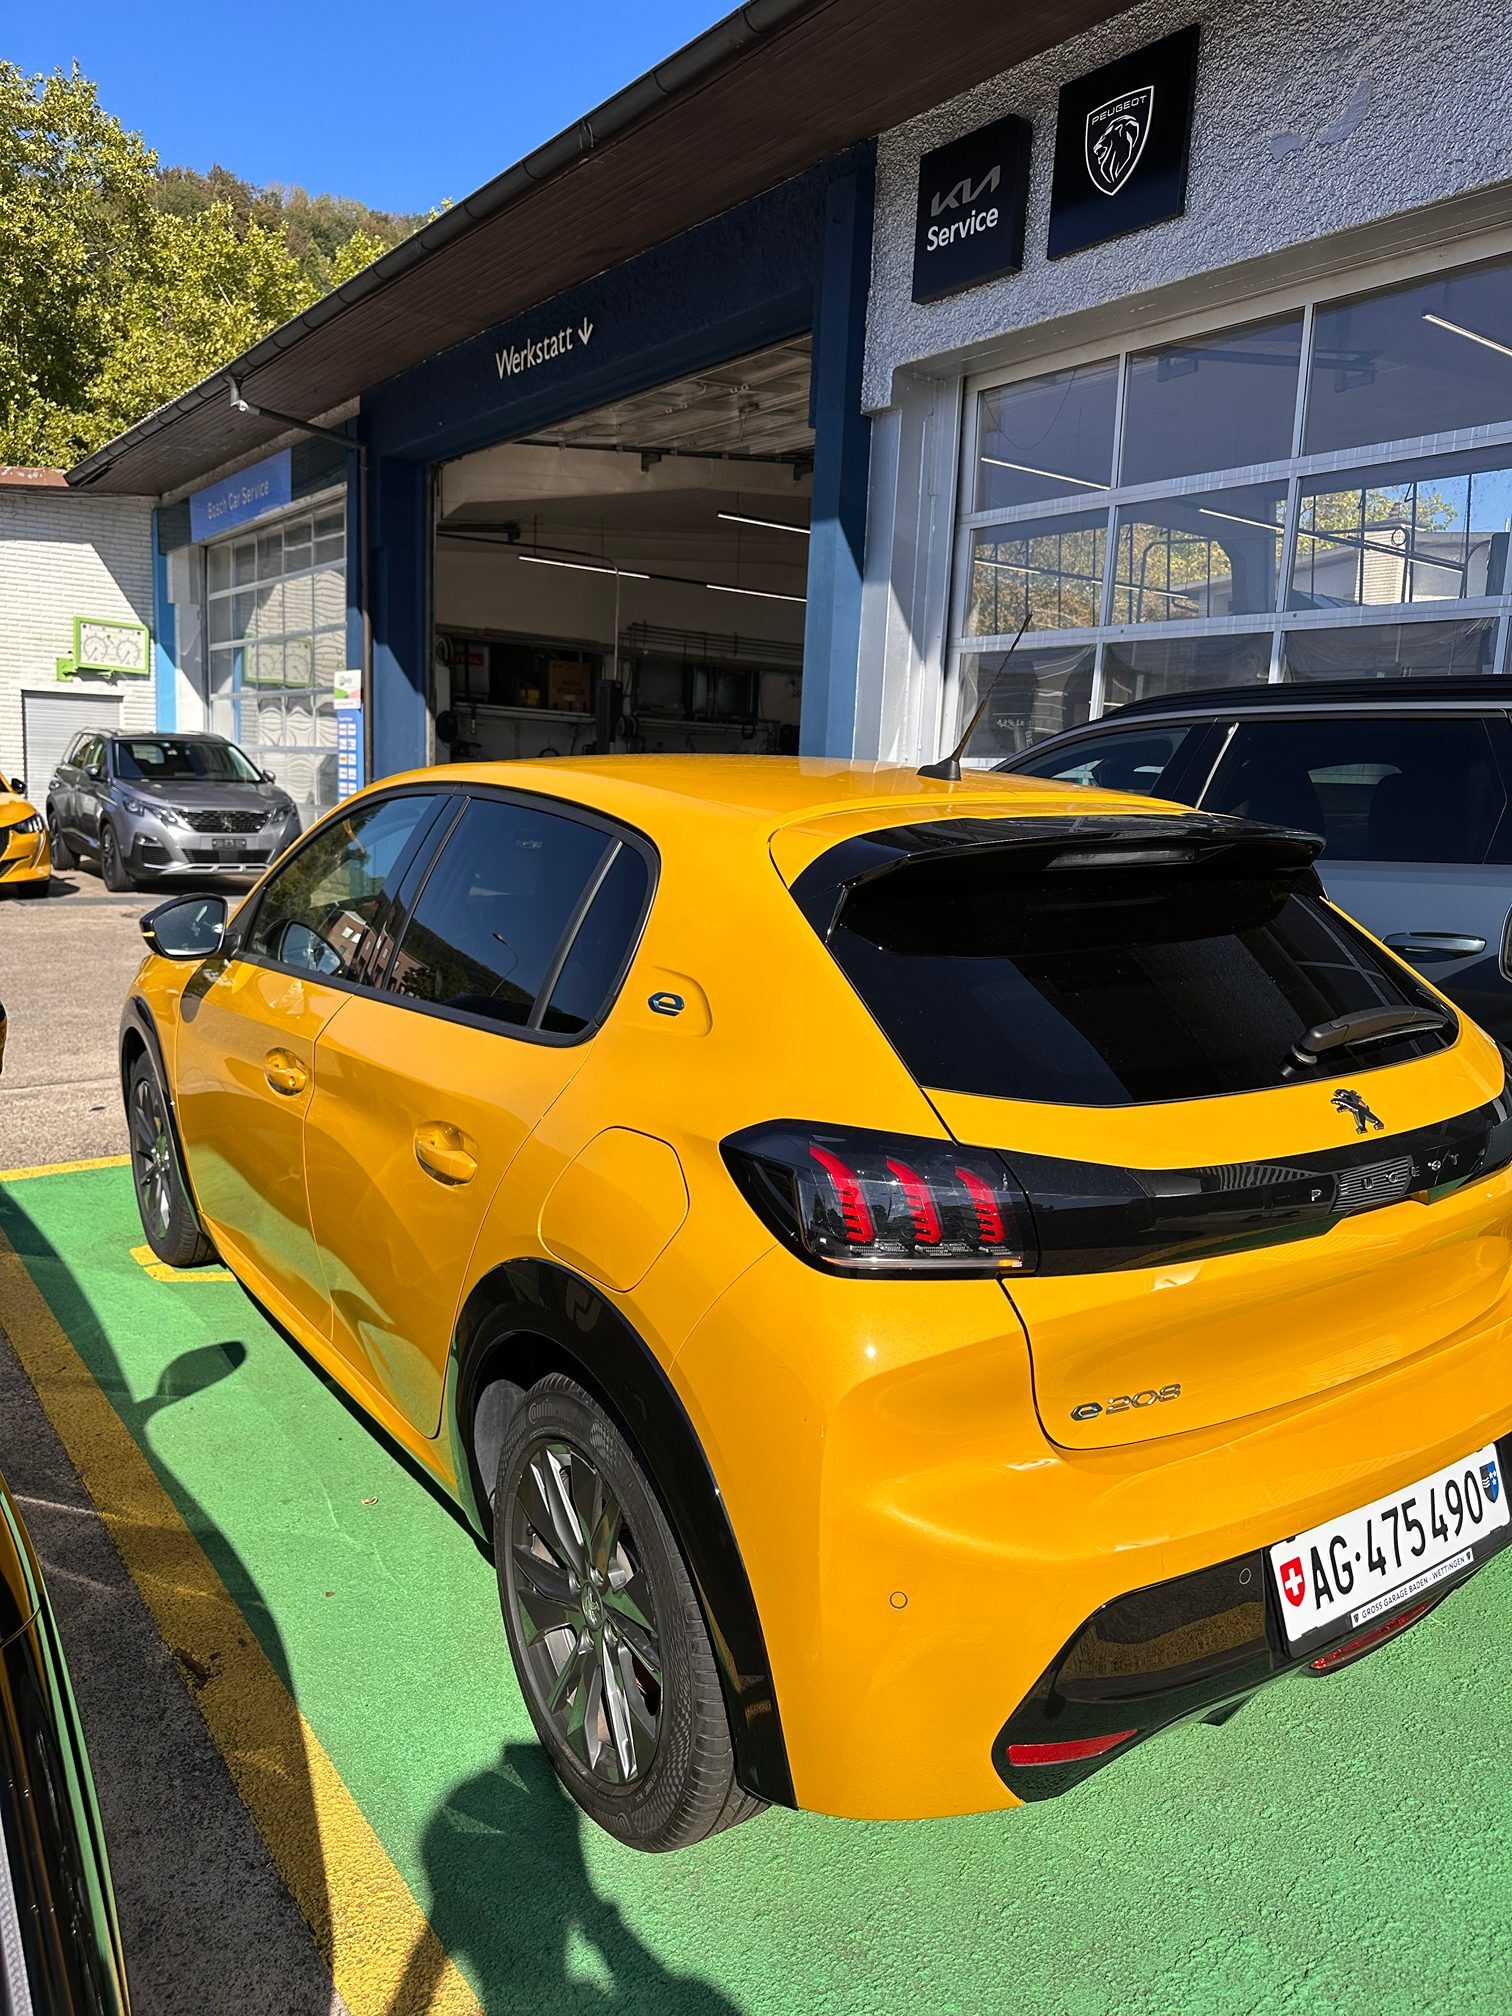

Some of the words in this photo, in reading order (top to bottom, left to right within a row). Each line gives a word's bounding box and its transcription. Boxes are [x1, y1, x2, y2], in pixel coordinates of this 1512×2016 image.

[1091, 95, 1147, 126] PEUGEOT
[926, 206, 999, 251] Service
[495, 326, 574, 380] Werkstatt
[228, 492, 241, 511] Car
[242, 481, 269, 505] Service
[1311, 1153, 1460, 1202] PEUGEOT
[1361, 1601, 1383, 1619] GROSS
[1383, 1588, 1408, 1606] GARAGE
[1408, 1577, 1429, 1593] BADEN
[1432, 1556, 1465, 1580] WETTINGEN
